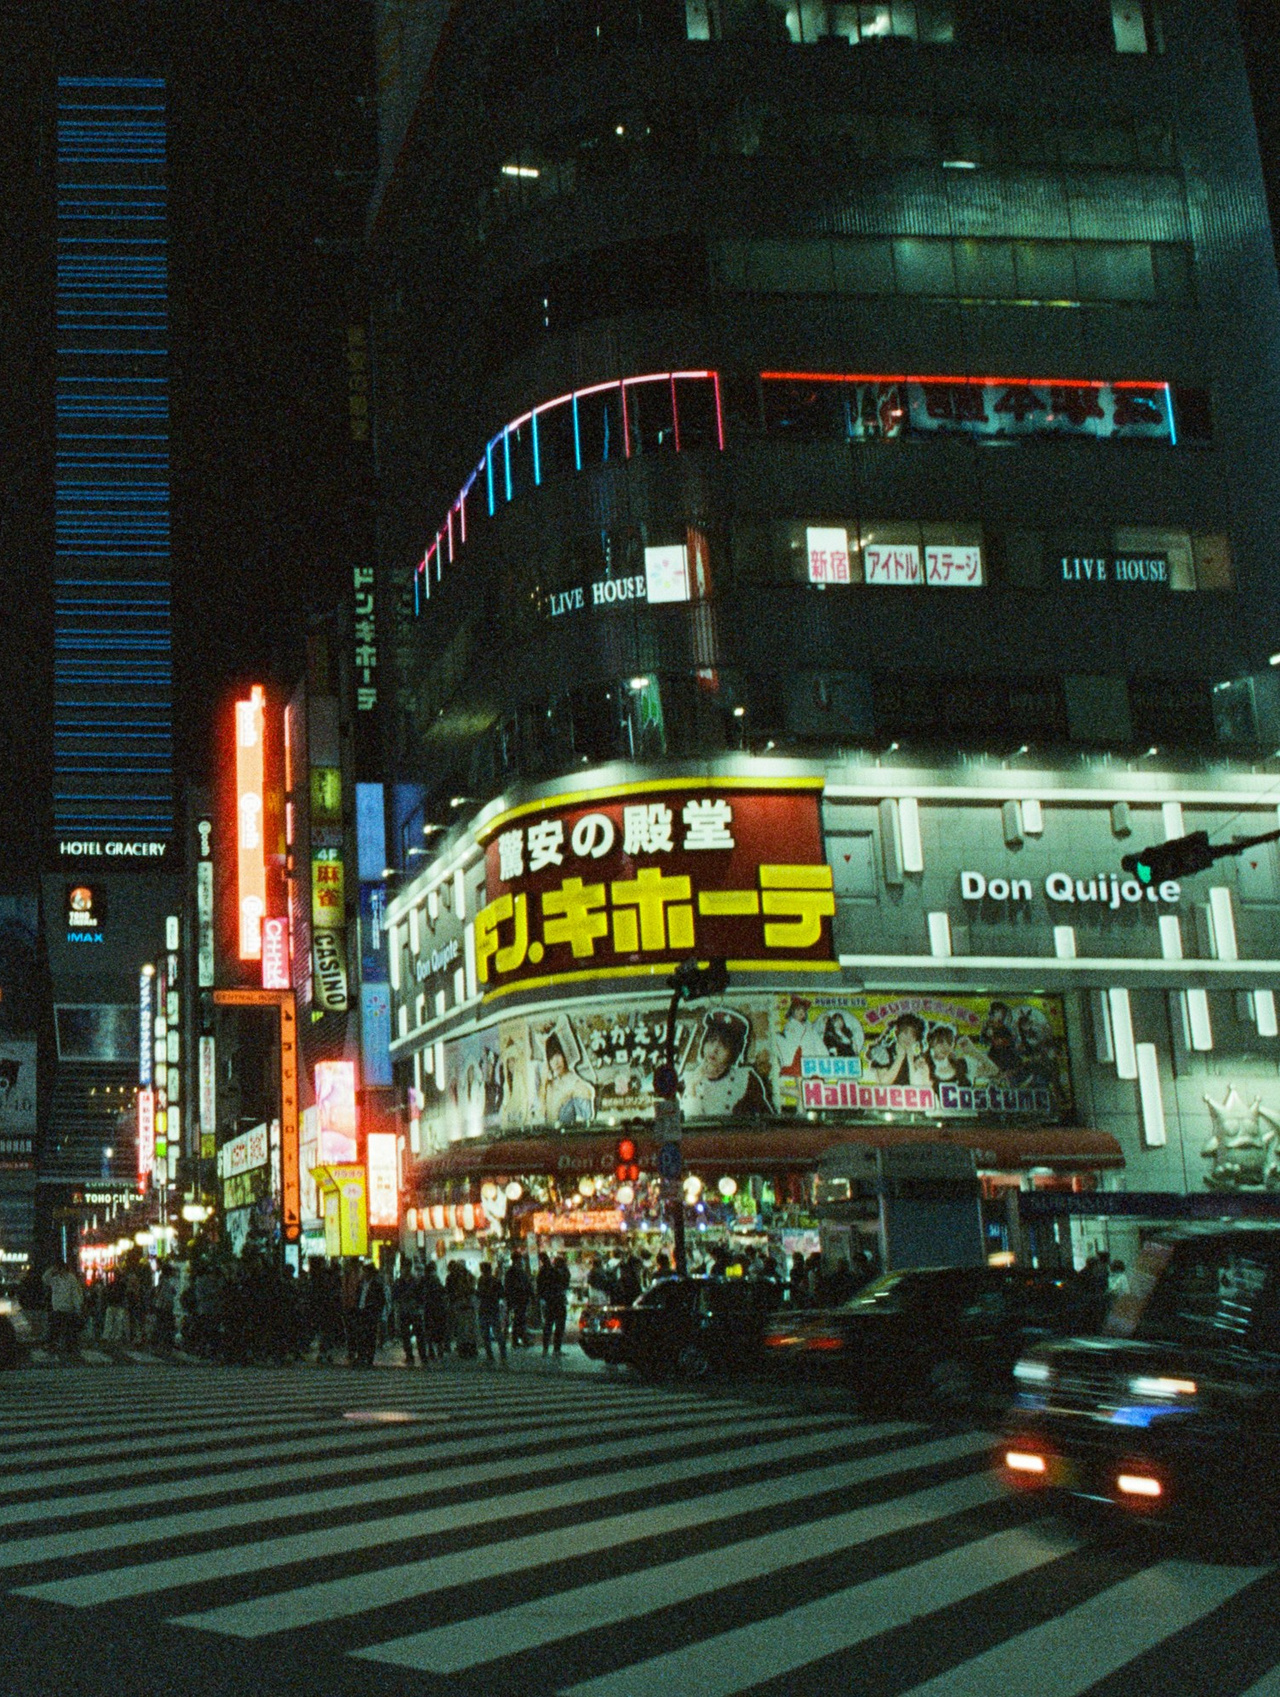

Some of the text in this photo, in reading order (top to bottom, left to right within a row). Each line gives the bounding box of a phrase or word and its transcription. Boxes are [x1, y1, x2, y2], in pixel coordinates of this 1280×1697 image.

[810, 551, 978, 582] 新宿 アイドル ステージ
[1061, 557, 1167, 582] LIVE HOUSE
[551, 575, 646, 616] LIVE HOUSE
[60, 842, 166, 857] HOTEL GRACERY
[498, 799, 735, 881] 驚安の殿堂
[316, 863, 340, 908] 麻雀
[961, 871, 1032, 901] Don
[67, 932, 104, 943] IMAX
[314, 932, 346, 1006] CASINO
[803, 1080, 934, 1109] Halloween
[85, 1193, 111, 1204] TOHO
